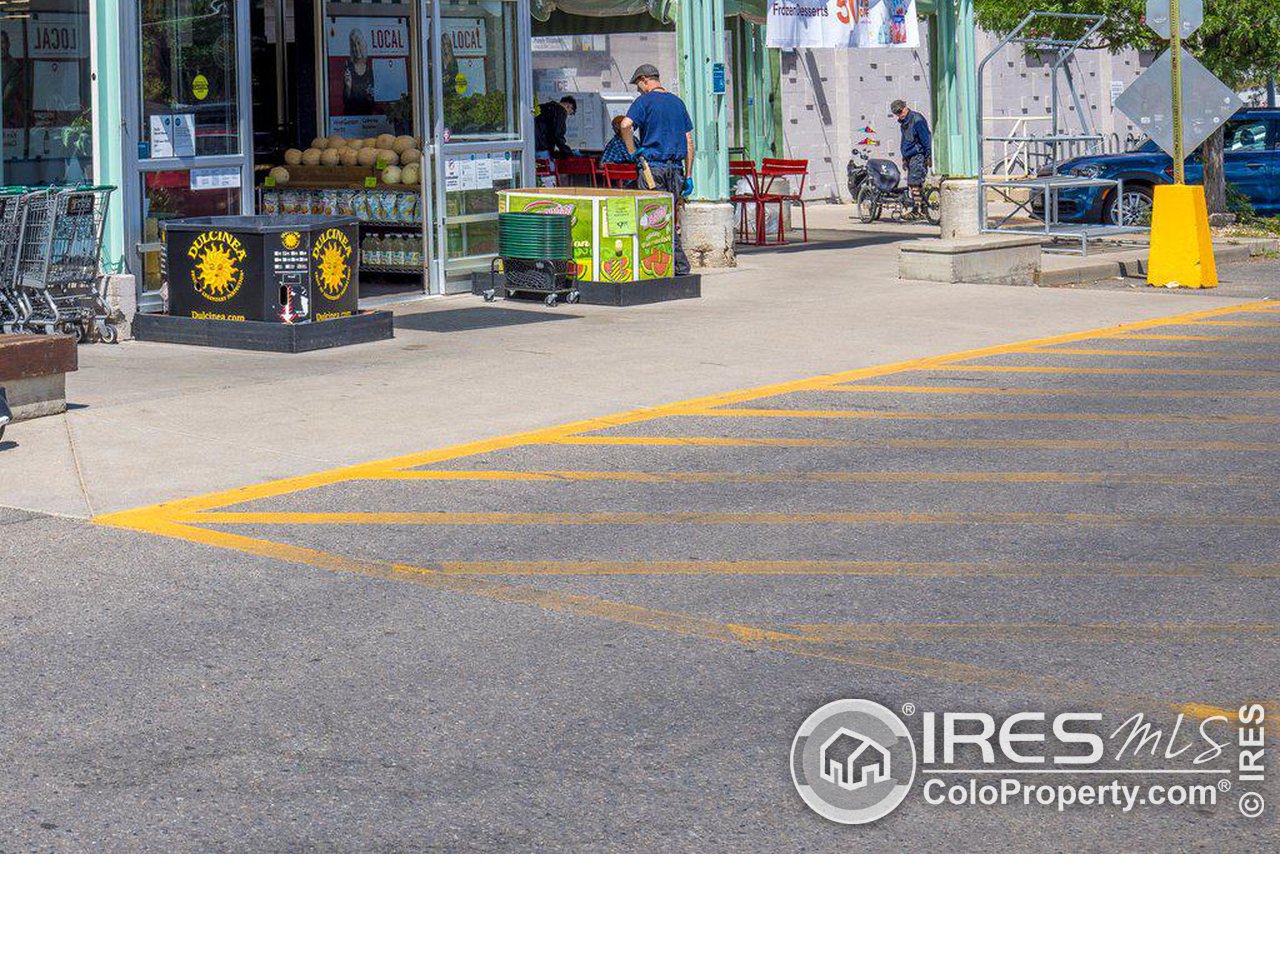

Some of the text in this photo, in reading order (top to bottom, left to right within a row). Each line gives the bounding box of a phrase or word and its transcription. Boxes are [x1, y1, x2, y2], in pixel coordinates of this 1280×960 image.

[371, 29, 404, 49] LOCAL
[451, 29, 483, 50] LOCAL
[187, 230, 247, 262] DULCINEA
[312, 228, 352, 260] DULCINEA
[191, 310, 245, 322] Dulcinea.com
